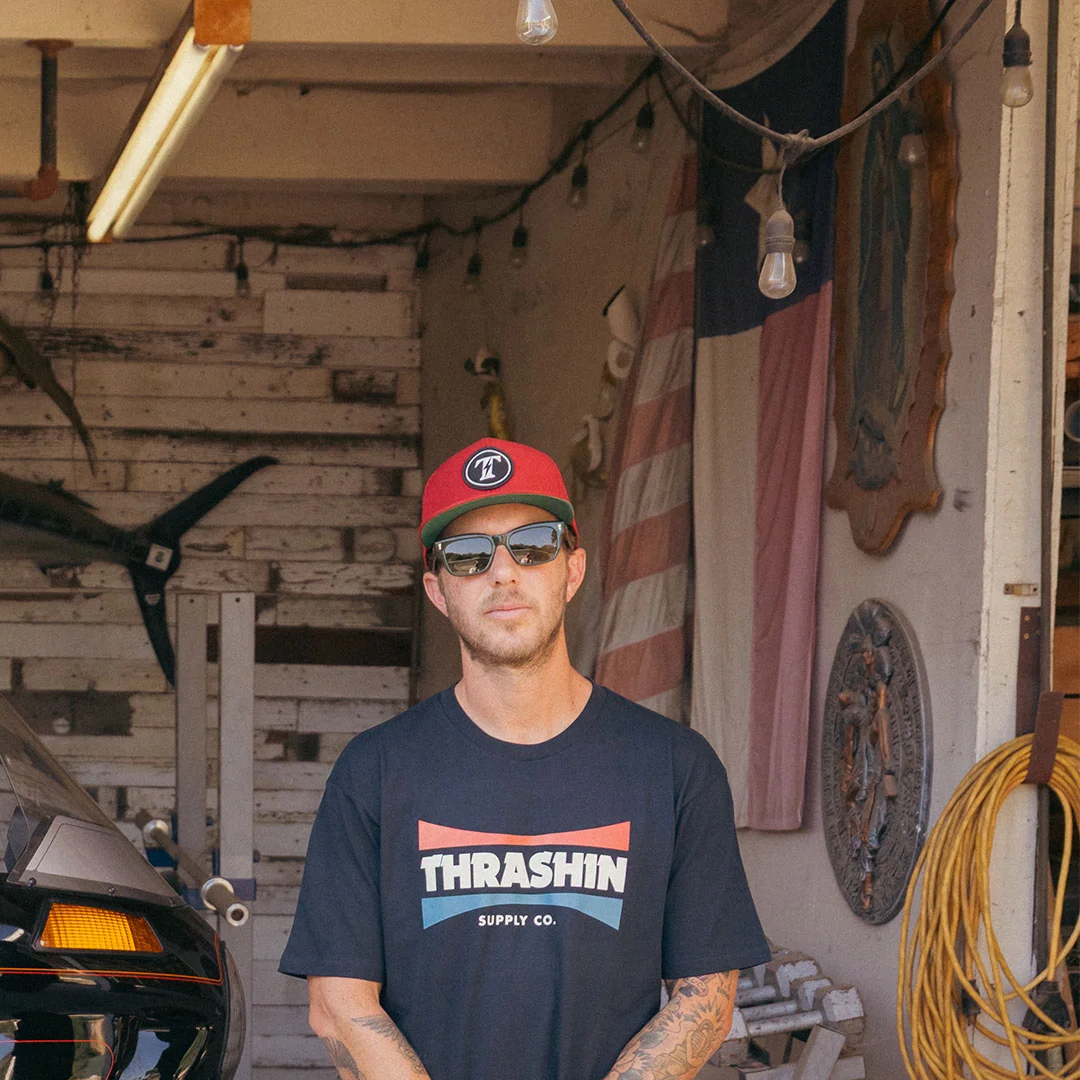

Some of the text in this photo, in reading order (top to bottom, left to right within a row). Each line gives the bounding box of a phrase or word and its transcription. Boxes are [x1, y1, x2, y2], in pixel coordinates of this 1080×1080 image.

[420, 850, 628, 893] THRASHIN
[478, 914, 557, 927] SUPPLY CO.
